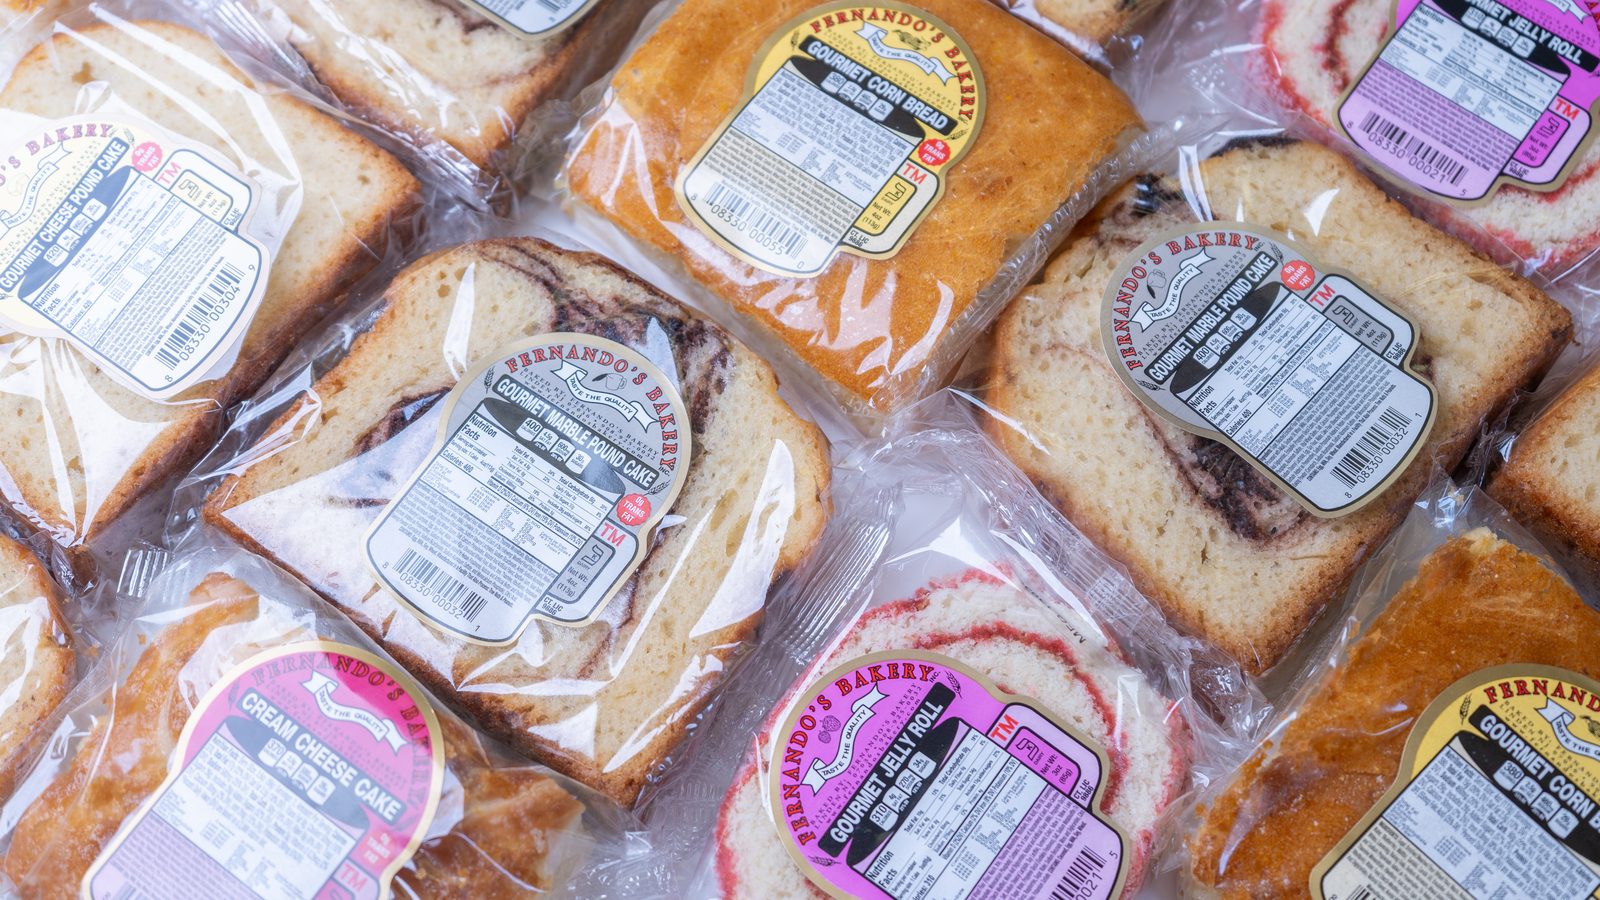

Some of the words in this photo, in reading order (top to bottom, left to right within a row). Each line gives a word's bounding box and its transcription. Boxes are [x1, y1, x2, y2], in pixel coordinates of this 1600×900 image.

[1509, 15, 1551, 45] JELLY
[1548, 36, 1583, 64] ROLL
[810, 8, 945, 43] FERNANDO'S
[944, 47, 975, 121] BAKERY
[904, 53, 932, 70] QUALITY
[807, 41, 872, 83] GOURMET
[867, 76, 905, 105] CORN
[902, 97, 949, 130] BREAD
[829, 73, 844, 85] 380
[1556, 98, 1580, 122] TM
[25, 123, 113, 156] BAKERY
[922, 153, 936, 164] FAT
[923, 144, 946, 160] TRANS
[158, 161, 182, 185] TM
[903, 162, 928, 185] TM
[1367, 131, 1405, 160] 08330
[1408, 154, 1447, 184] 00021
[1459, 188, 1467, 197] 5
[0, 239, 46, 288] GOURMET
[39, 202, 78, 242] CHEESE
[69, 169, 105, 206] POUND
[97, 140, 127, 171] CAKE
[25, 196, 34, 212] THE
[872, 201, 883, 212] Net
[862, 215, 880, 231] (113g)
[872, 211, 883, 221] 4oz
[691, 193, 698, 201] 8
[710, 204, 747, 232] 08330
[748, 228, 785, 256] 00055
[796, 260, 805, 269] 0
[859, 233, 870, 244] LIC
[46, 246, 60, 261] 420
[1173, 267, 1194, 292] QUALITY
[1284, 264, 1295, 275] 0g
[1286, 263, 1308, 287] TRANS
[1299, 274, 1312, 287] FAT
[35, 282, 61, 310] Nutrition
[43, 297, 61, 314] Facts
[1113, 251, 1163, 371] FERNANDO'S
[1166, 231, 1260, 256] BAKERY
[1169, 291, 1178, 308] THE
[1309, 284, 1337, 309] TM
[66, 311, 83, 329] Calories:
[165, 375, 174, 383] 8
[179, 323, 211, 362] 08330
[208, 285, 242, 322] 00304
[248, 264, 256, 272] 9
[1148, 341, 1194, 381] GOURMET
[1187, 305, 1227, 344] MARBLE
[1216, 278, 1253, 312] POUND
[1245, 255, 1276, 283] CAKE
[1151, 308, 1171, 319] TASTE
[1353, 327, 1365, 339] Net
[1365, 328, 1378, 340] 4oz
[1370, 331, 1388, 349] (113g)
[1197, 345, 1210, 361] 400
[1385, 347, 1396, 360] CT.
[1392, 341, 1404, 353] LIC
[505, 344, 648, 386] FERNANDO'S
[518, 370, 551, 395] LINDEN
[569, 378, 584, 397] TASTE
[585, 393, 601, 401] THE
[604, 396, 633, 415] QUALITY
[1189, 383, 1214, 409] Nutrition
[1198, 397, 1217, 417] Facts
[469, 413, 498, 438] Nutrition
[523, 377, 643, 462] www.fernandosbakery.com
[524, 419, 541, 434] 400
[568, 395, 624, 436] FERNANDO'S
[624, 432, 659, 458] BAKERY
[646, 386, 678, 471] BAKERY
[1225, 414, 1246, 436] Calories:
[1240, 407, 1252, 419] 400
[460, 424, 481, 441] Facts
[497, 378, 551, 419] GOURMET
[545, 407, 591, 446] MARBLE
[586, 434, 624, 468] POUND
[623, 458, 657, 489] CAKE
[442, 449, 464, 468] Calories:
[463, 463, 474, 473] 400
[658, 466, 672, 477] INC.
[1344, 491, 1352, 499] 8
[1357, 456, 1384, 484] 08330
[1382, 427, 1409, 456] 00032
[623, 500, 646, 518] TRANS
[635, 496, 644, 506] 0g
[621, 511, 634, 523] FAT
[601, 522, 627, 547] TM
[566, 577, 578, 588] 4oz
[567, 566, 579, 577] Net
[382, 561, 390, 569] 8
[399, 572, 431, 597] 08330
[431, 594, 464, 620] 00032
[556, 582, 576, 598] (113g)
[543, 596, 554, 607] CT.
[553, 601, 564, 612] LIC
[252, 654, 405, 701] FERNANDO'S
[1483, 679, 1600, 712] FERNAND
[334, 709, 350, 718] THE
[354, 712, 384, 734] QUALITY
[845, 709, 866, 740] QUALITY
[991, 713, 1020, 743] TM
[242, 692, 299, 742] CREAM
[294, 732, 358, 788] CHEESE
[354, 774, 403, 822] CAKE
[783, 694, 833, 846] FERNANDO'S
[835, 662, 935, 697] BAKERY
[929, 670, 941, 683] INC.
[842, 742, 850, 758] THE
[1032, 749, 1044, 766] DAIRY
[1572, 743, 1591, 753] THE
[822, 761, 845, 777] TASTE
[829, 772, 886, 844] GOURMET
[879, 732, 917, 778] JELLY
[907, 700, 944, 739] ROLL
[1040, 762, 1051, 776] Net
[1051, 763, 1064, 778] 3oz
[1057, 767, 1073, 786] (85g)
[1480, 714, 1555, 781] GOURMET
[1548, 775, 1596, 820] CORN
[1503, 762, 1522, 780] 380
[1073, 788, 1084, 801] CT.
[1080, 777, 1092, 791] LIC
[871, 804, 888, 823] 310
[867, 850, 894, 880] Nutrition
[1075, 872, 1103, 900] 0021
[1109, 850, 1118, 859] 5
[339, 863, 369, 893] TM
[878, 868, 898, 889] Facts
[925, 874, 936, 887] 310
